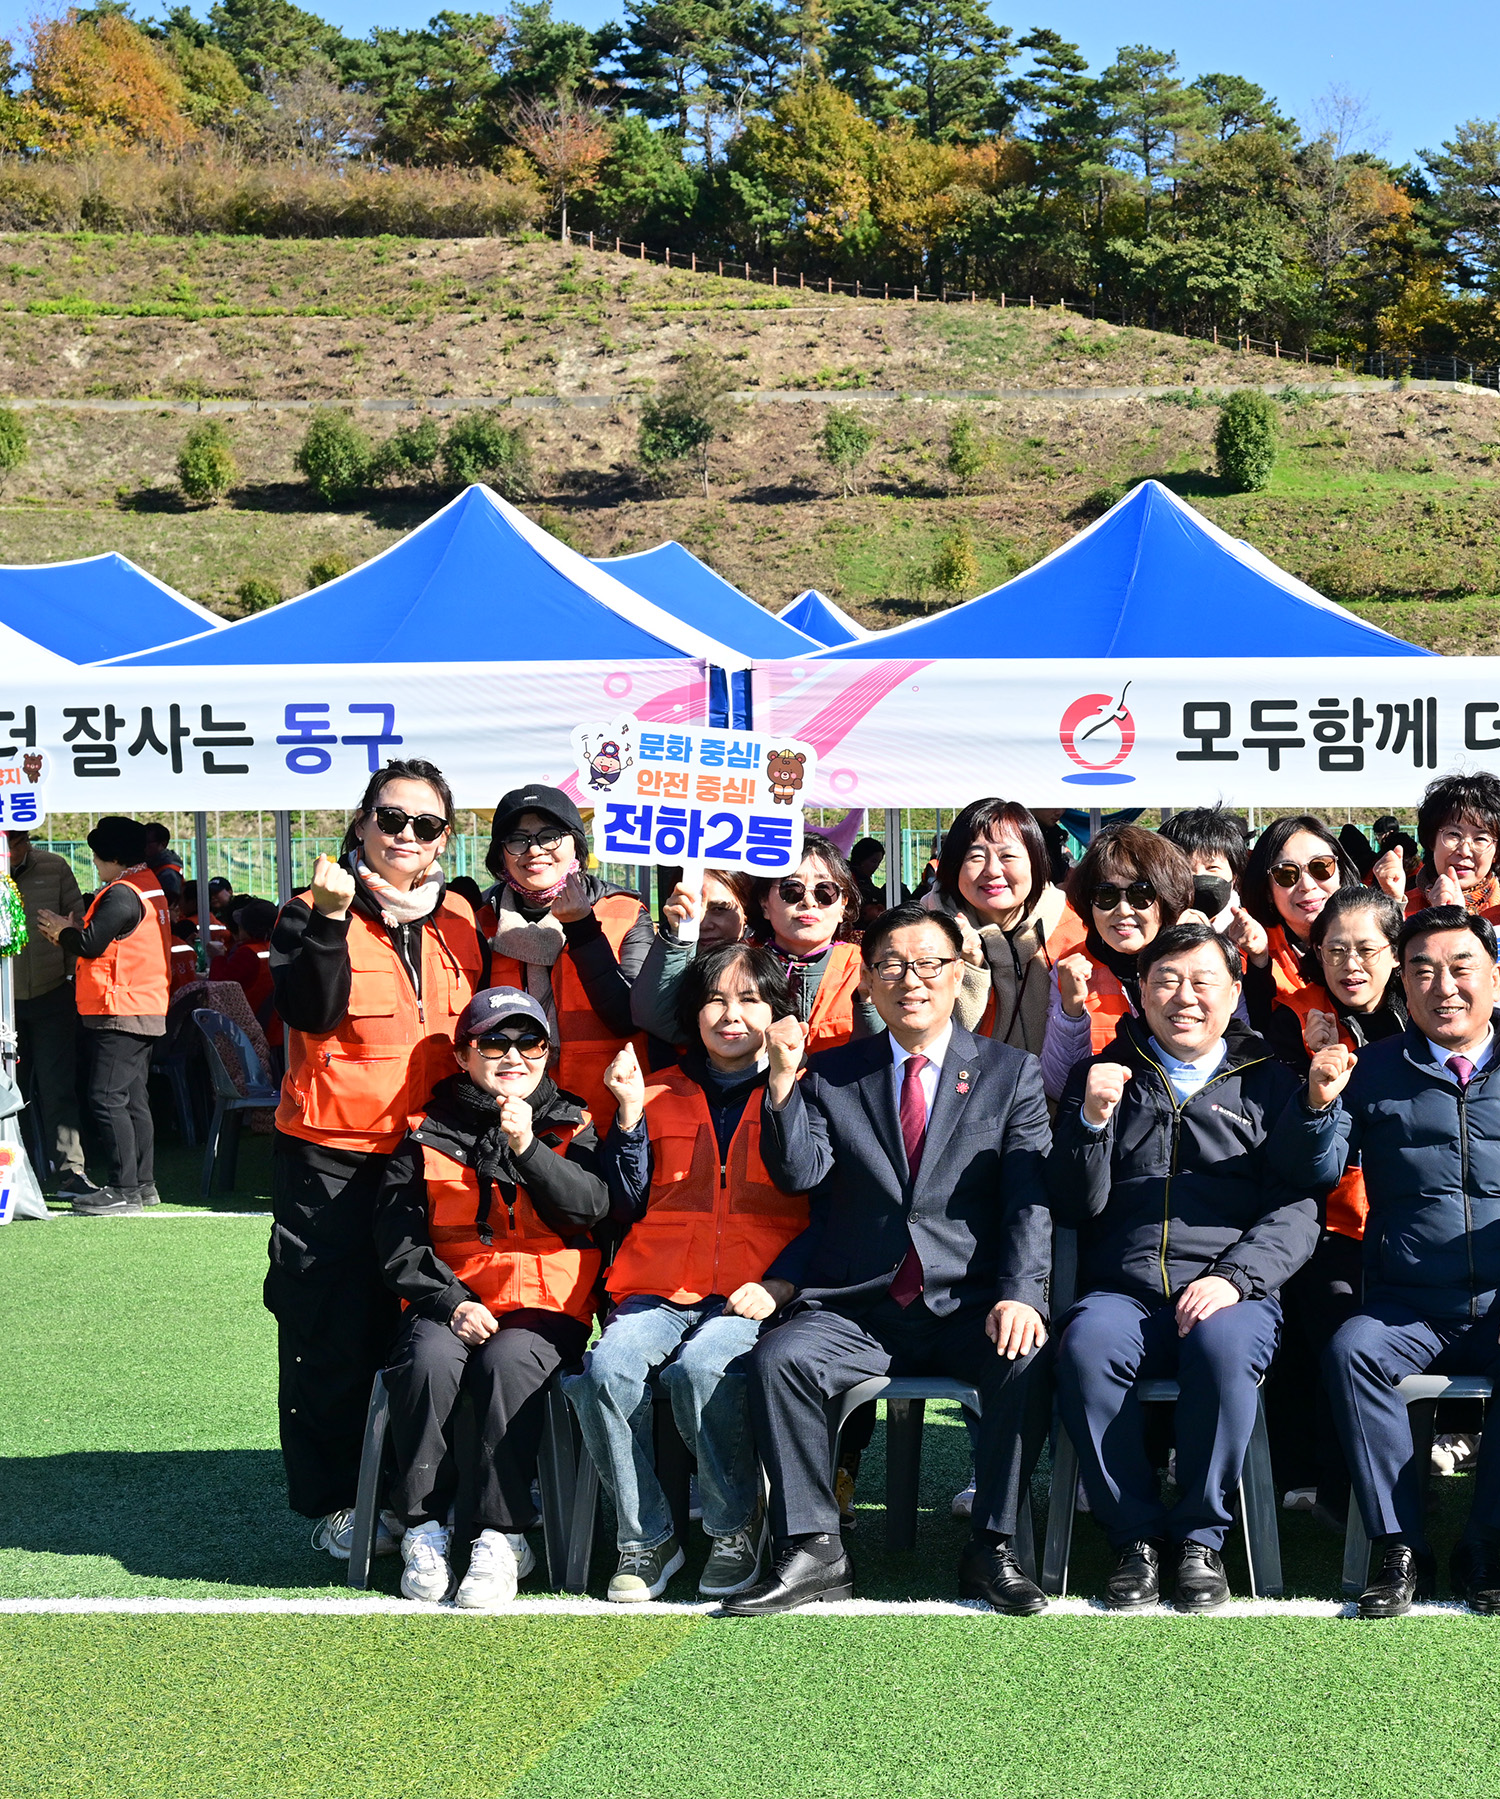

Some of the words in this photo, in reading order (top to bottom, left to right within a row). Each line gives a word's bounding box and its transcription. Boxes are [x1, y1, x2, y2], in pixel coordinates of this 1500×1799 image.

[62, 703, 254, 777] 잘사는
[276, 703, 403, 774] 동구
[638, 732, 693, 763] 문화
[699, 738, 761, 769] 중심!
[1176, 696, 1437, 771] 모두함께
[636, 769, 689, 799] 안전
[695, 774, 756, 804] 중심!
[603, 803, 793, 867] 전하2동
